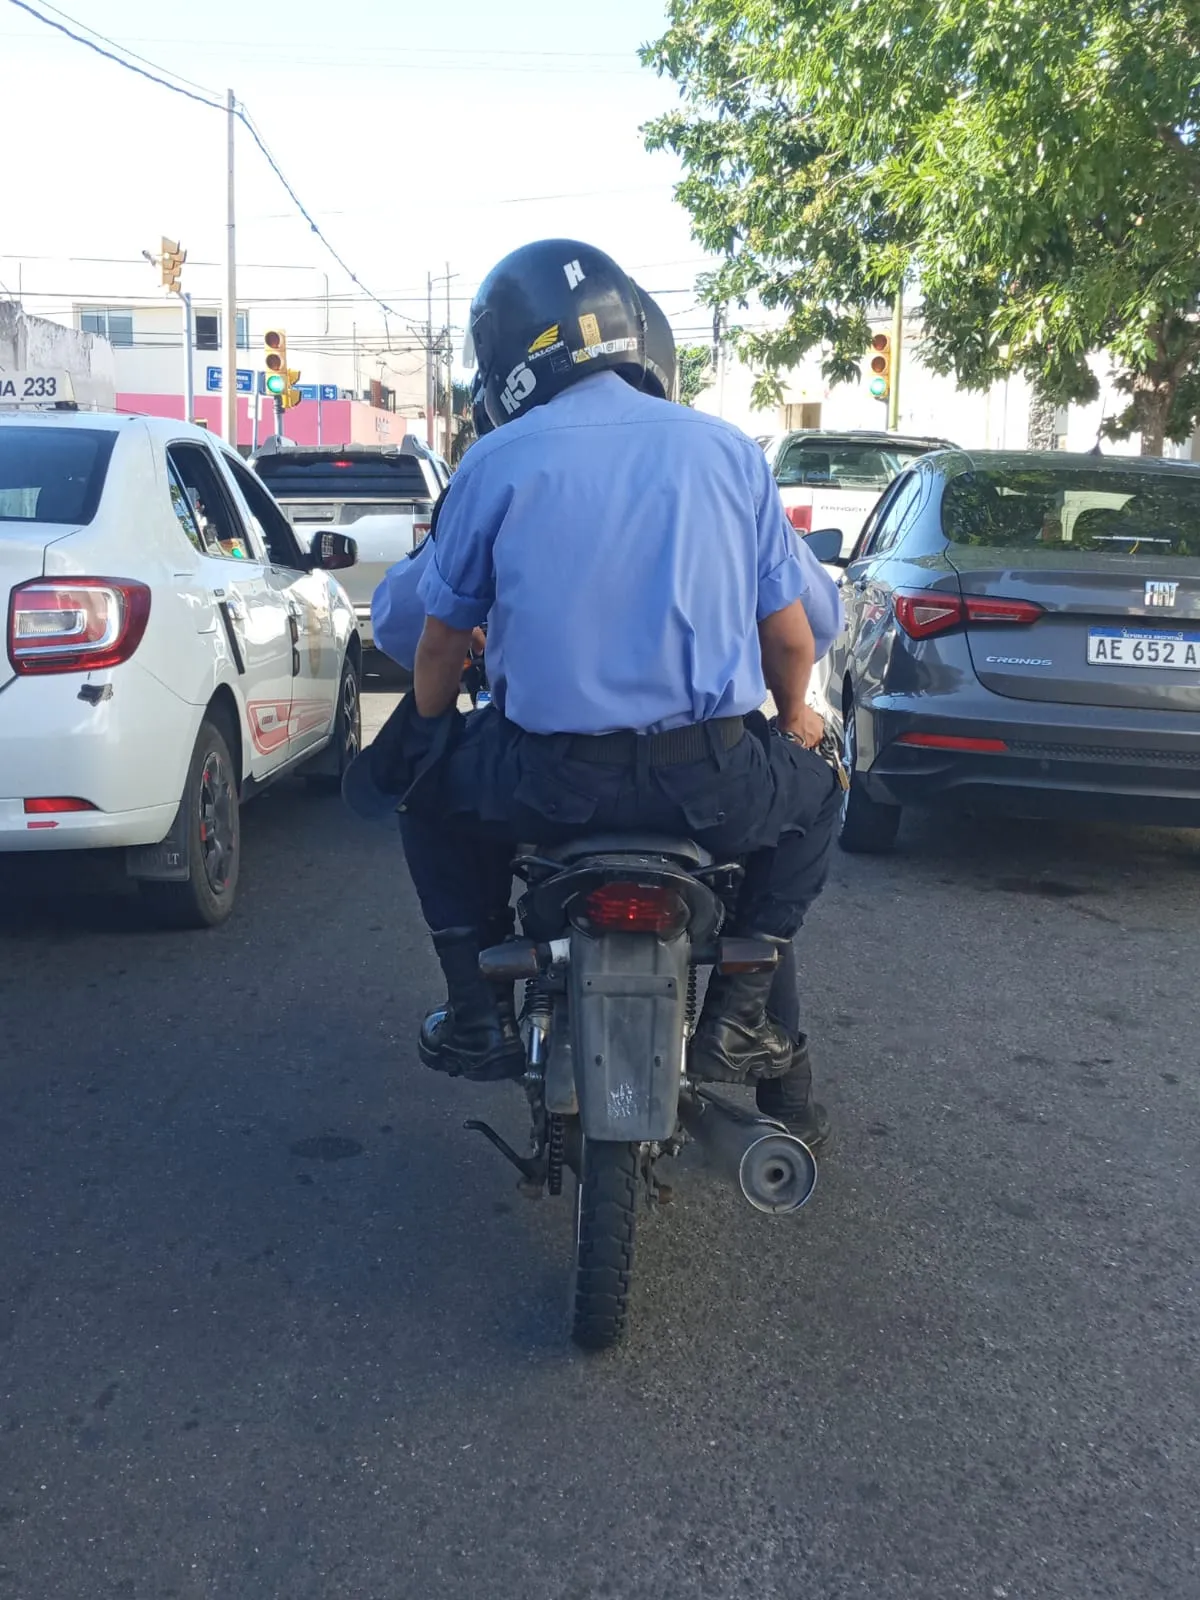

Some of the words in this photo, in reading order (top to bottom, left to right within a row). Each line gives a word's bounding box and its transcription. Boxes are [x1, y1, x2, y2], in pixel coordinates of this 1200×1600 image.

[563, 259, 586, 291] H
[0, 380, 17, 397] A
[23, 377, 57, 397] 233
[1144, 581, 1180, 607] FIAT
[985, 655, 1053, 667] CRONOS
[1096, 639, 1123, 660] AE
[1132, 641, 1175, 664] 652
